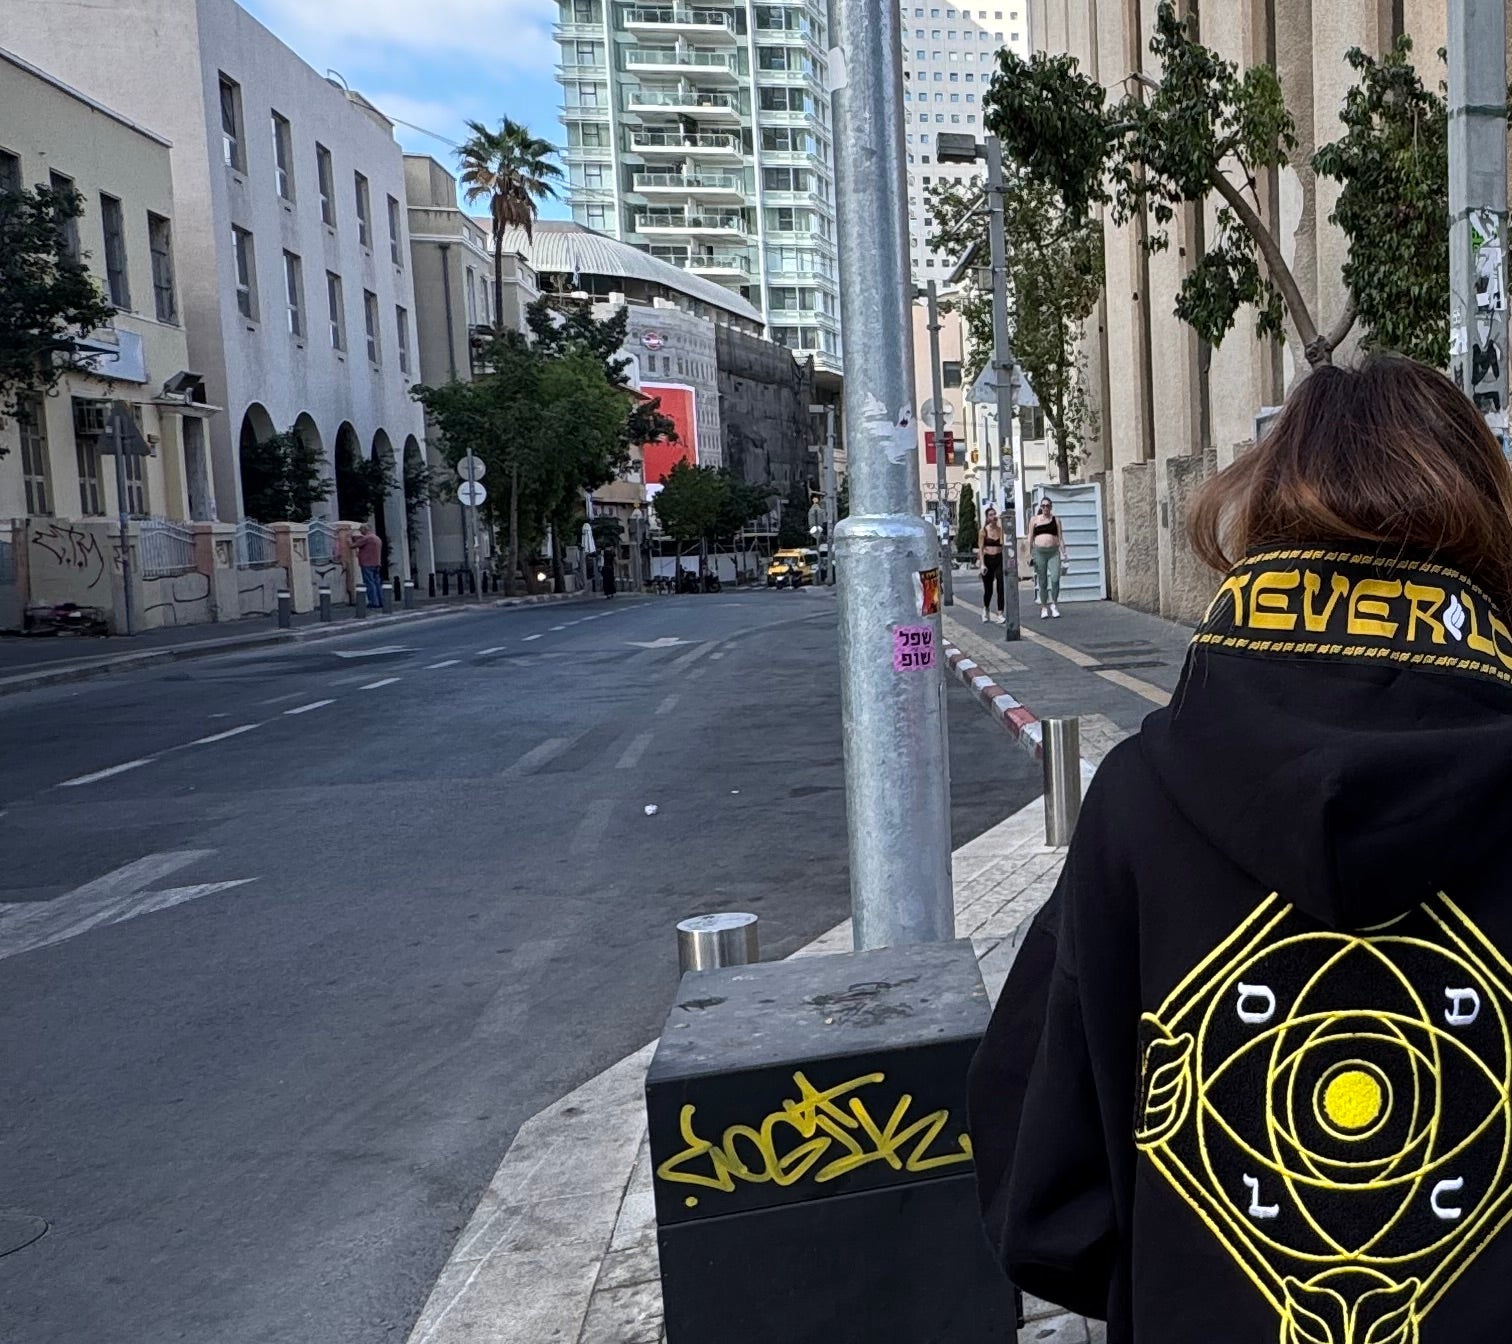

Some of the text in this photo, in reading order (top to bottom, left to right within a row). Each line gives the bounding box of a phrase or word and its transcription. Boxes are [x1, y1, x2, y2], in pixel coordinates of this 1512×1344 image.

[1444, 986, 1481, 1027] D
[1242, 1173, 1279, 1219] L
[1430, 1176, 1464, 1219] C
